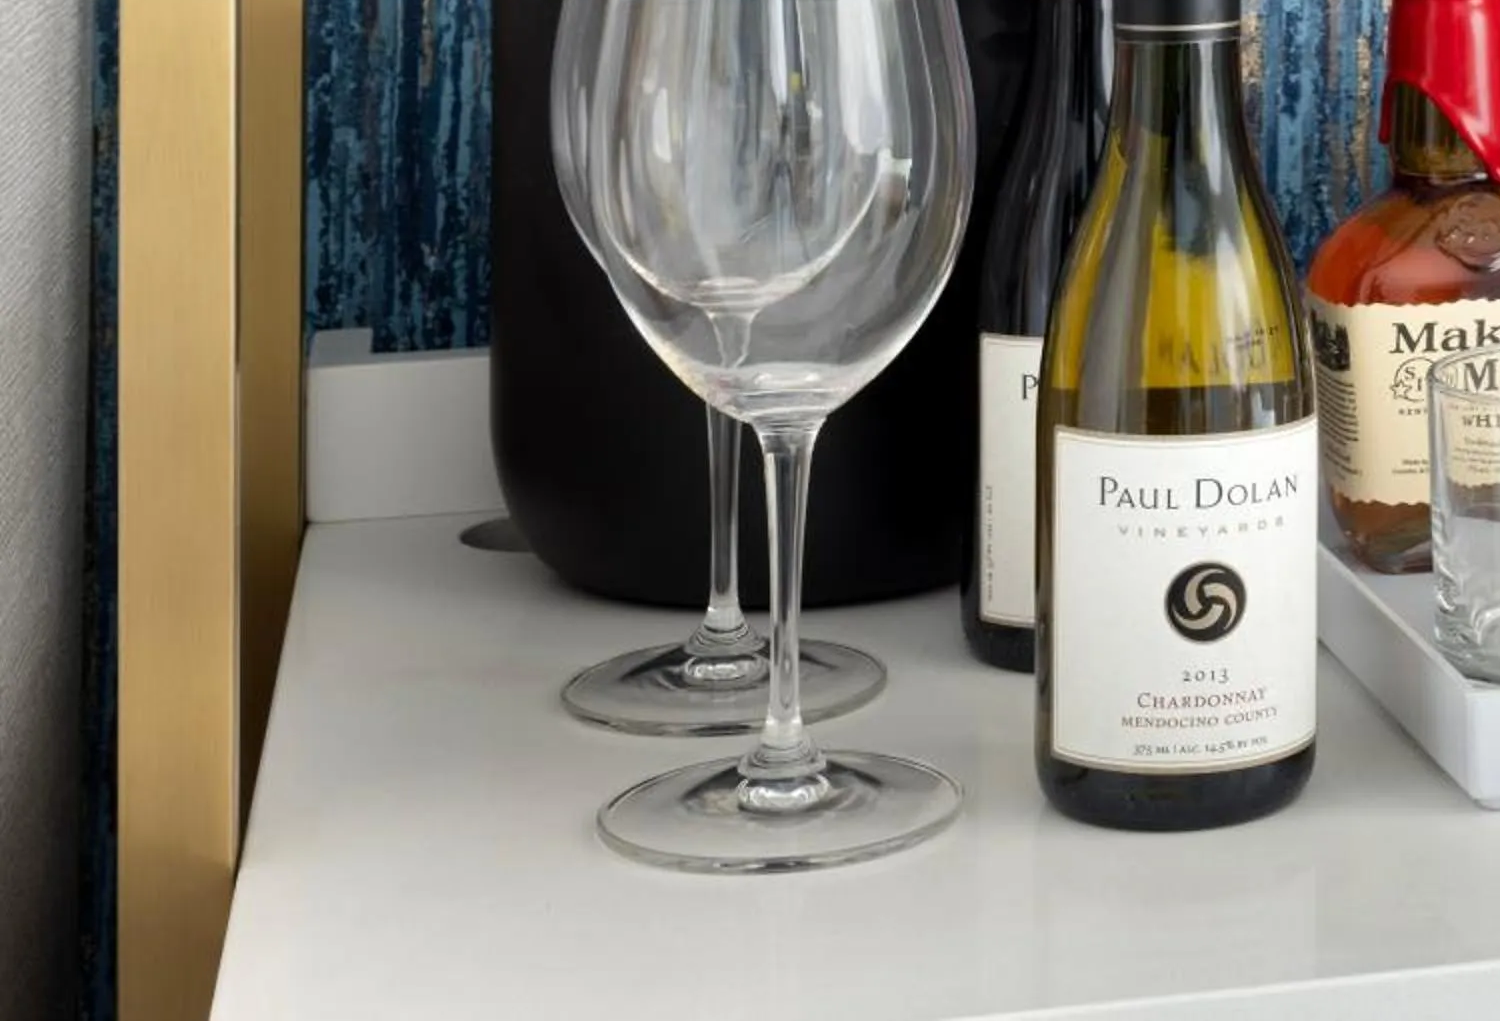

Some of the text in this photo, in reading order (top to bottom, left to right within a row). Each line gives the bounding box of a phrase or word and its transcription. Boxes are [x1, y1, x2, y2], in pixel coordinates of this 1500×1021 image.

[1099, 475, 1297, 510] PAUL DOLAN
[1117, 516, 1284, 538] VINEYARDS
[1182, 669, 1229, 684] 2013
[1137, 687, 1267, 710] CHARDONNAY
[1121, 706, 1278, 729] MENDOCINO COUNTY
